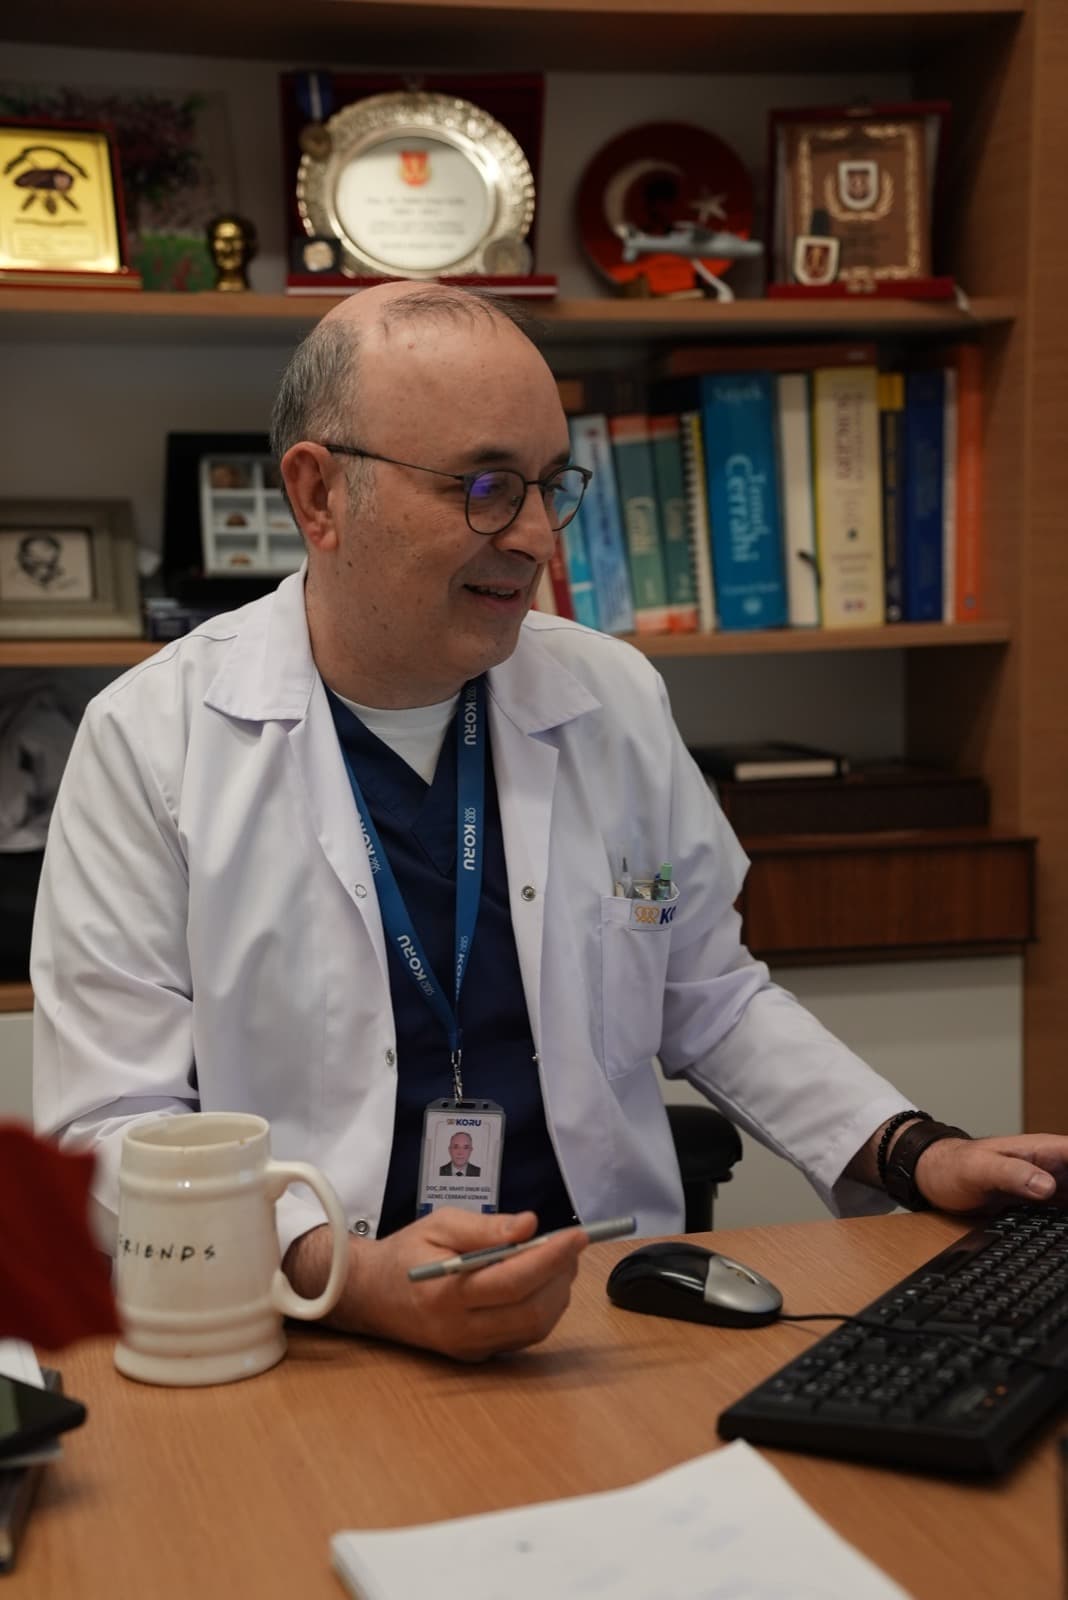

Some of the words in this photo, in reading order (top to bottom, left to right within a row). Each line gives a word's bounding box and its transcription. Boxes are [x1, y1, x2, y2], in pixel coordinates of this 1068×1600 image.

[464, 702, 477, 745] KORU
[463, 824, 476, 871] KORU
[397, 935, 428, 981] KORU
[456, 1119, 482, 1127] KORU
[119, 1234, 217, 1261] RIENDS
